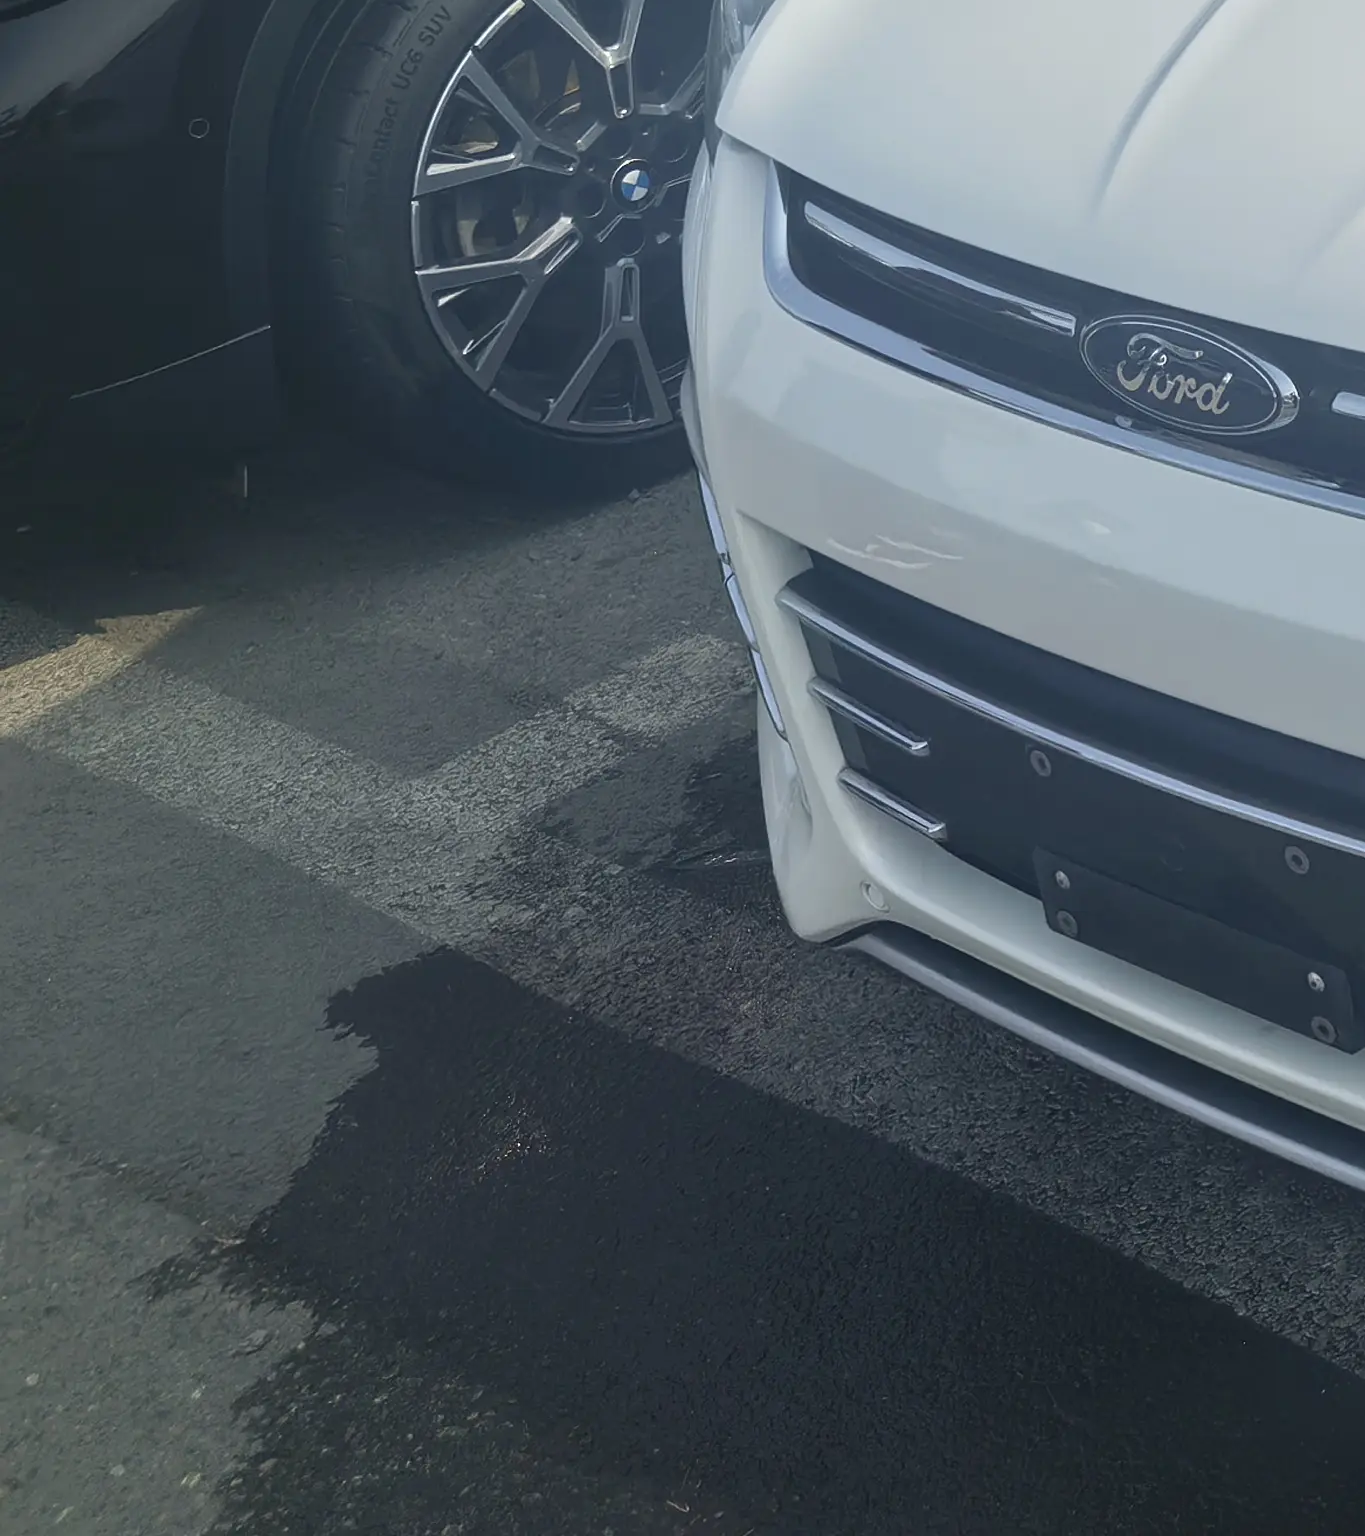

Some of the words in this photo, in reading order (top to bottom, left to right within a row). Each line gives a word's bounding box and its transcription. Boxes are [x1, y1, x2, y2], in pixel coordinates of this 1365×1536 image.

[391, 48, 424, 90] UC6
[417, 5, 452, 47] SUV
[1116, 332, 1233, 415] Ford
